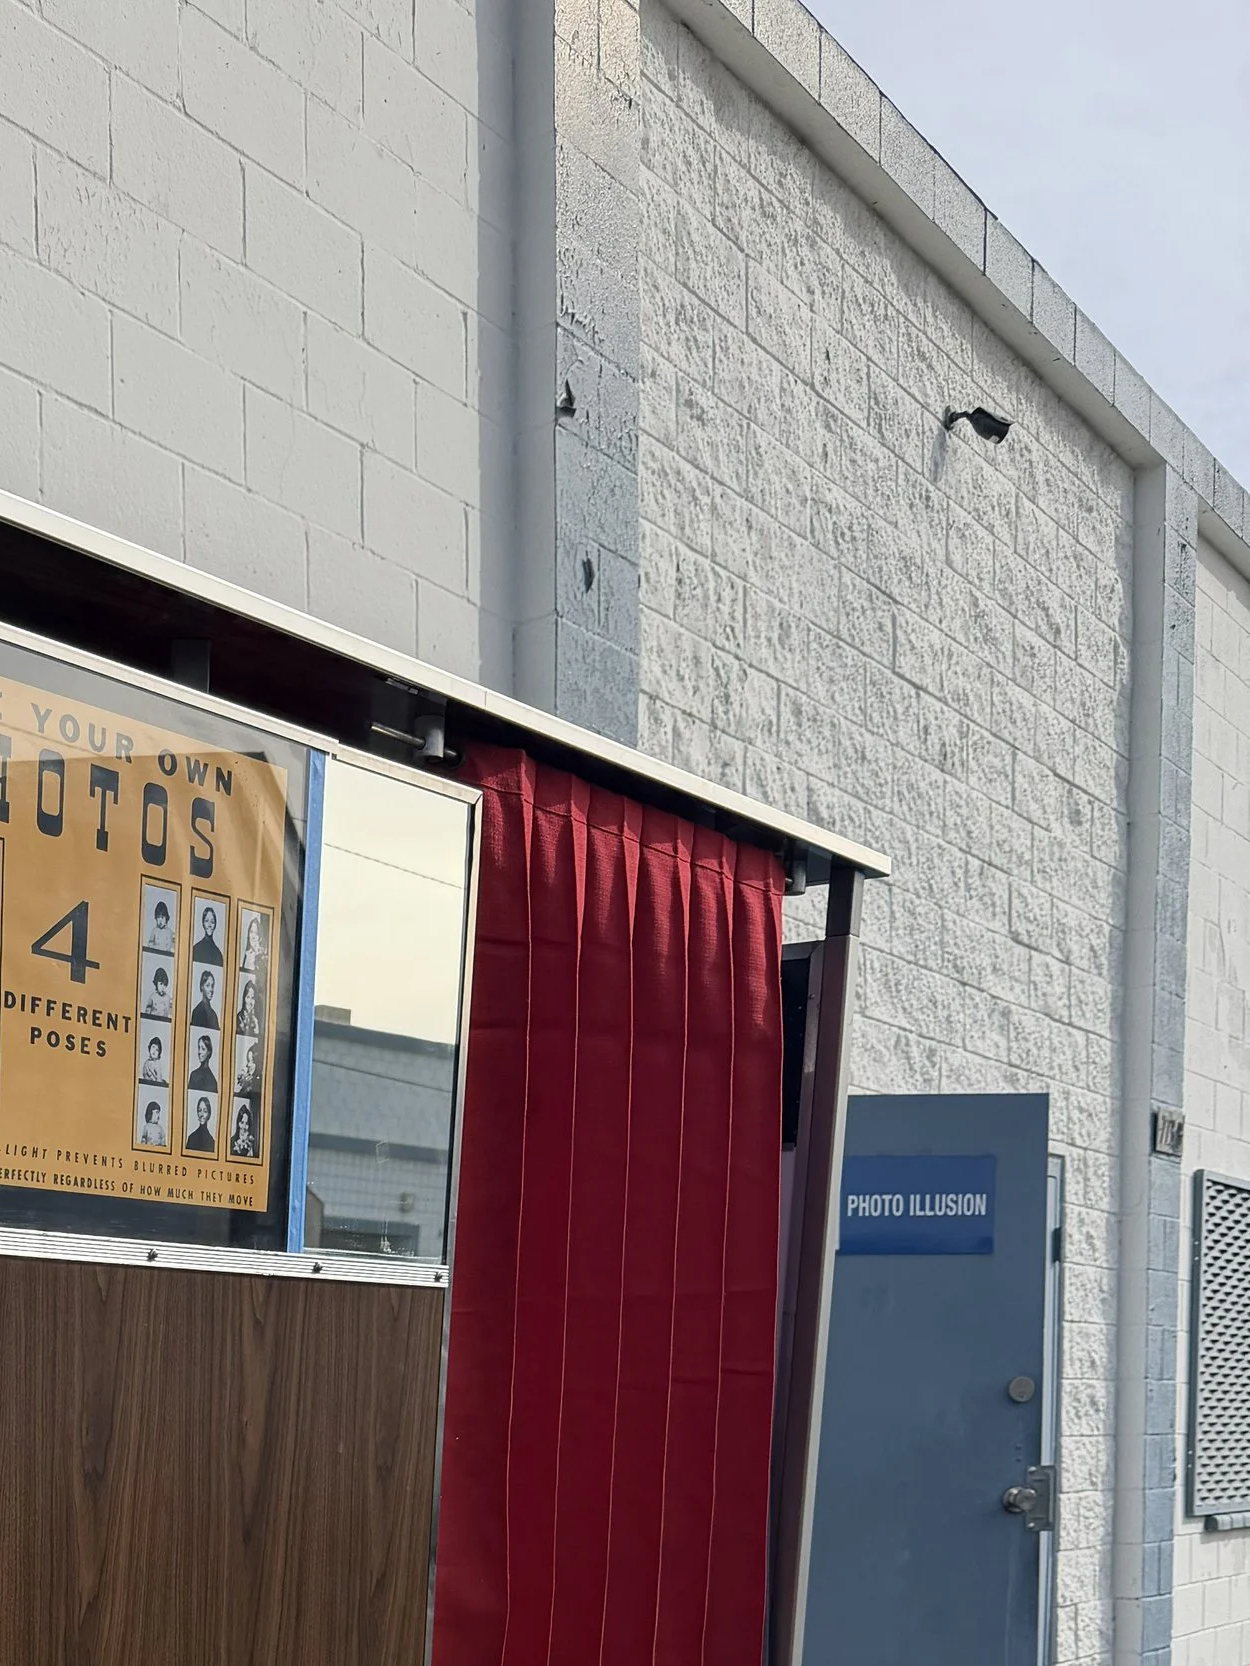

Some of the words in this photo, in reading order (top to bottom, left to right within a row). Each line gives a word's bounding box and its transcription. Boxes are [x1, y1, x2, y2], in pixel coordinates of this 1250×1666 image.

[31, 702, 135, 764] YOUR
[158, 748, 233, 796] OWN
[31, 899, 100, 984] 4
[4, 990, 131, 1034] DIFFERENT
[30, 1027, 107, 1058] POSES
[56, 1149, 123, 1169] PREVENTS
[133, 1160, 187, 1177] BLURRED
[197, 1168, 254, 1185] PICTURES
[53, 1172, 115, 1191] REGARDLESS
[122, 1181, 134, 1193] OF
[140, 1184, 161, 1197] HOW
[167, 1187, 194, 1200] MUCH
[201, 1190, 223, 1204] THEY
[228, 1193, 253, 1207] MOVE
[846, 1193, 904, 1217] PHOTO
[909, 1192, 987, 1216] ILLUSION
